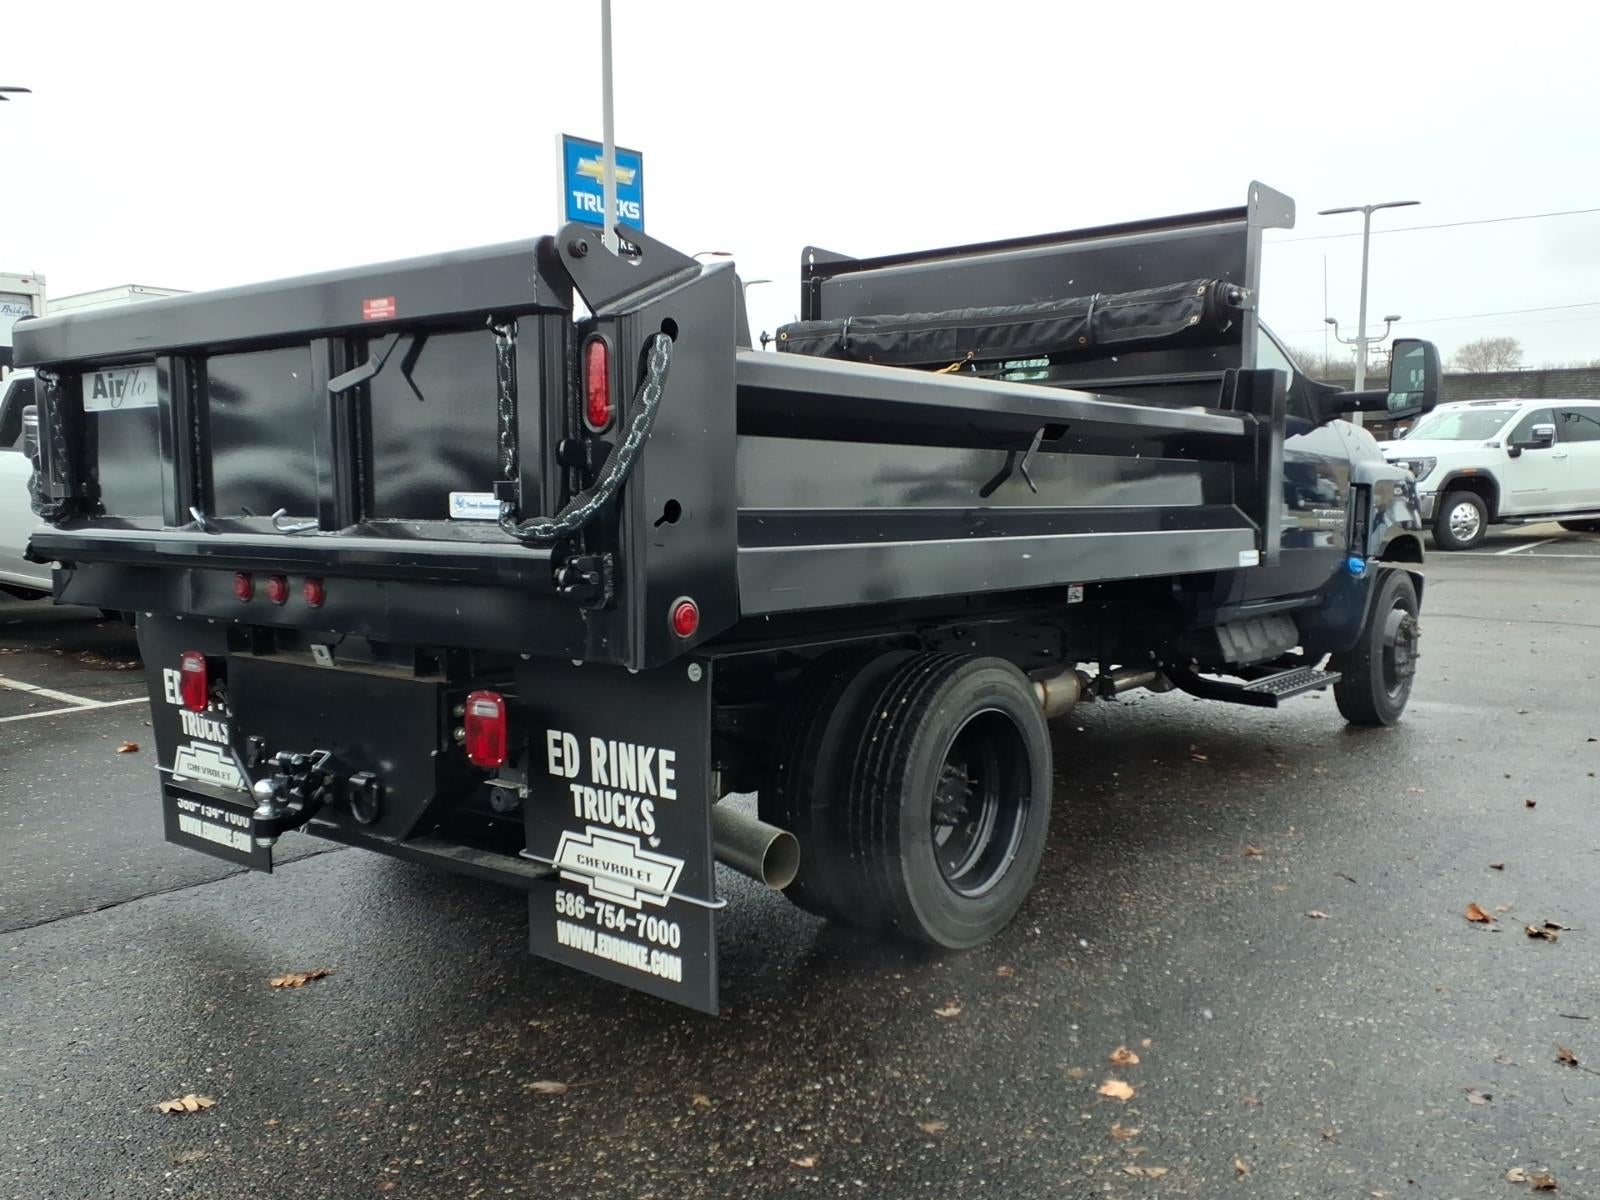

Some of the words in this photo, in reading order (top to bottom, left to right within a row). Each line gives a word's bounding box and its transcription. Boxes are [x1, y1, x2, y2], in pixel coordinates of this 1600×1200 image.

[92, 368, 146, 408] Airflo
[179, 709, 229, 745] TRUCKS
[186, 762, 231, 780] CHEVROLET
[547, 729, 580, 778] ED
[590, 737, 677, 800] RINKE
[570, 784, 656, 835] TRUCKS
[576, 853, 654, 882] CHEVROLET
[555, 890, 681, 948] 586-754-7000
[556, 920, 682, 983] WWW.EDRINKE.COM
